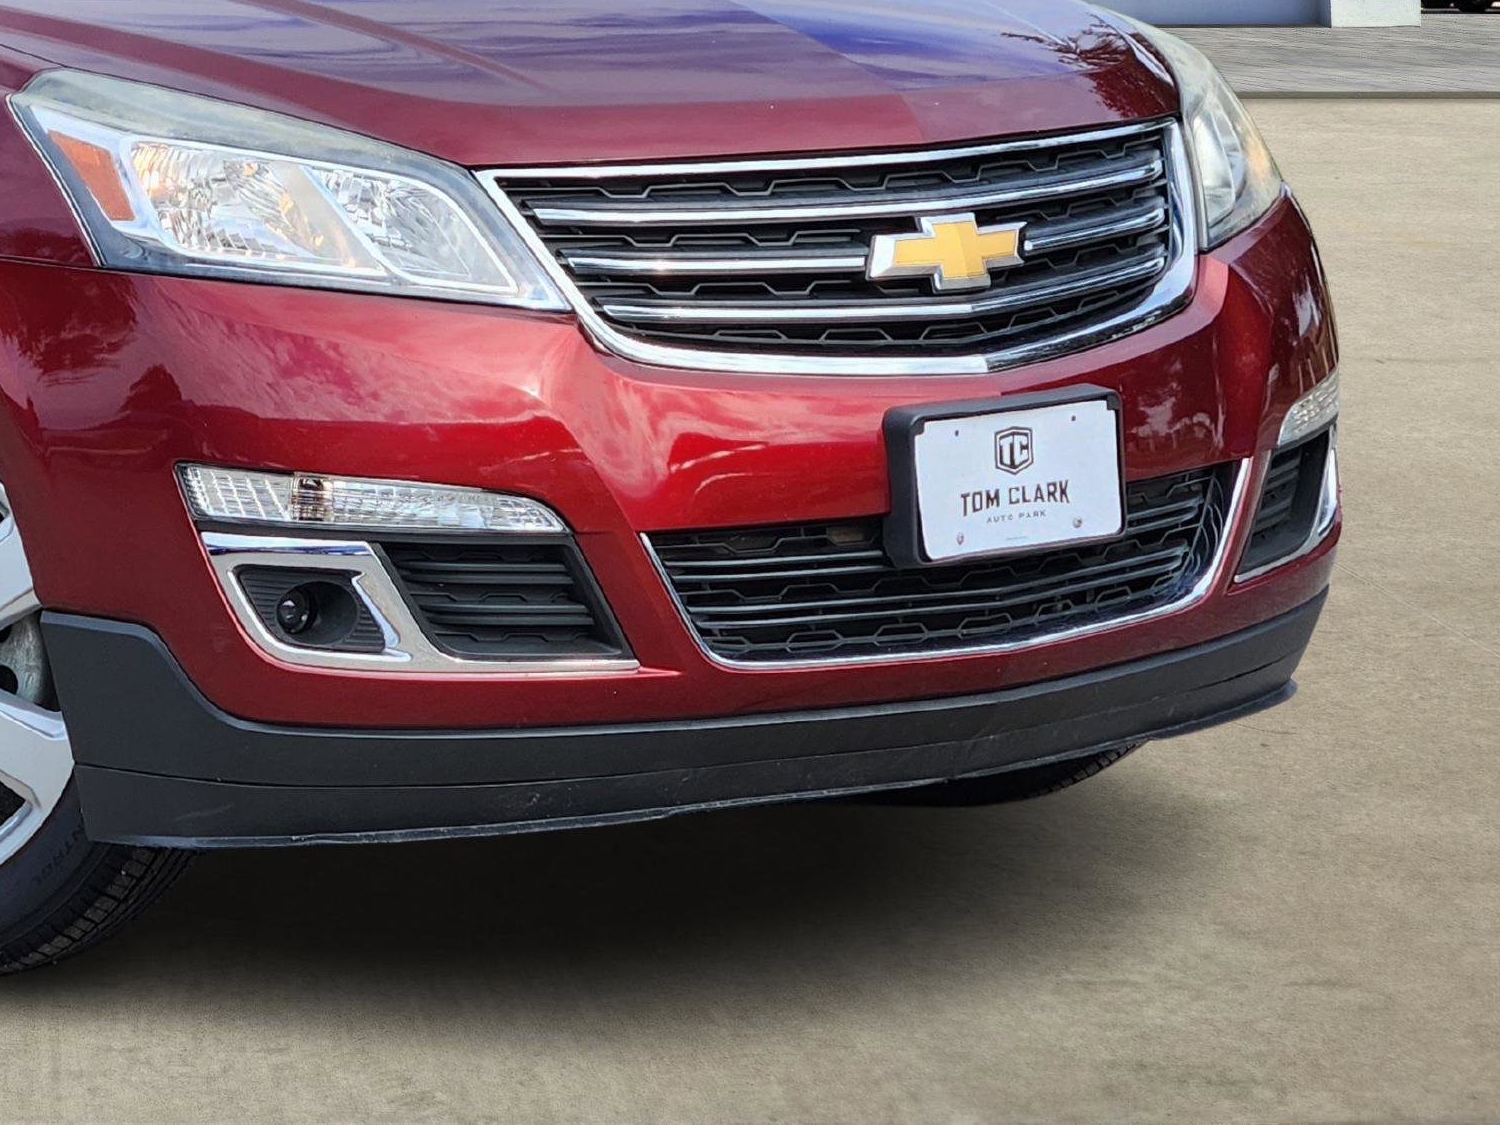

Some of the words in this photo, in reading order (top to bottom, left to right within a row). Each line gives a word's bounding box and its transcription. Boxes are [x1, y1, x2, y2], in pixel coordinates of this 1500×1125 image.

[960, 488, 1001, 517] TOM
[1008, 479, 1071, 505] CLARK
[986, 513, 1014, 524] AUTO
[1018, 510, 1047, 519] PARK
